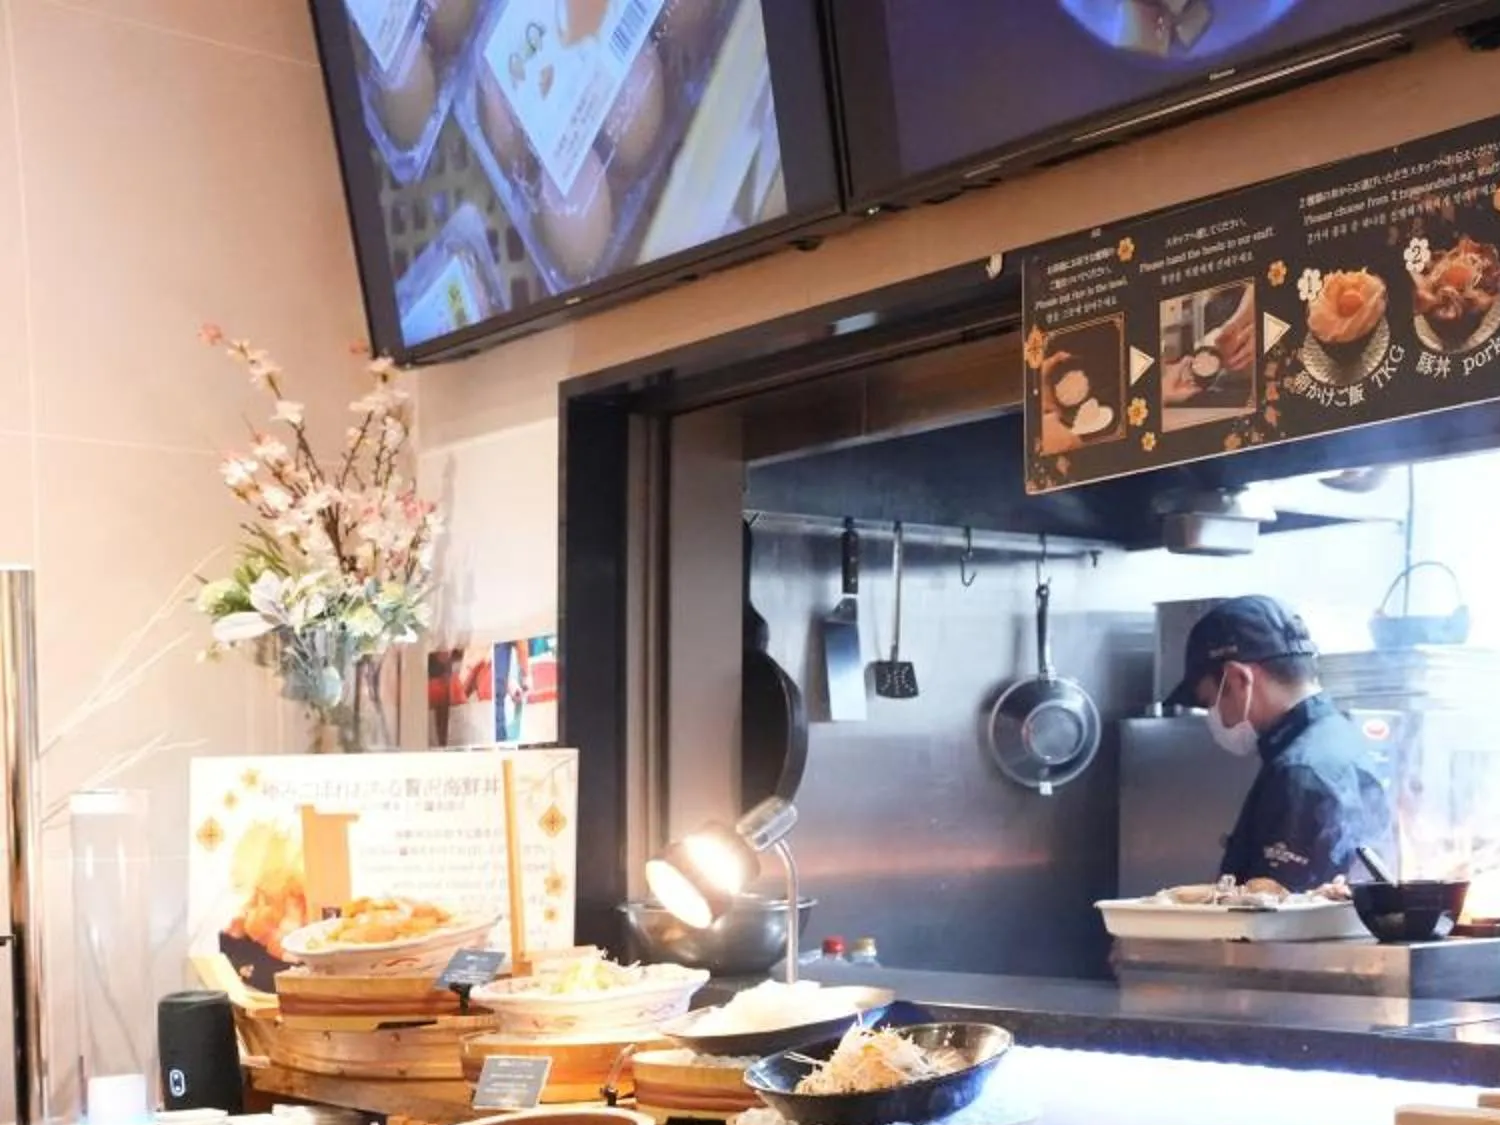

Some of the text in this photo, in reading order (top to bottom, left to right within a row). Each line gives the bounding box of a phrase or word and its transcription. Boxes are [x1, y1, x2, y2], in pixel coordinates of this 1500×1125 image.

[1367, 194, 1389, 209] from
[1370, 343, 1405, 390] TKG
[1415, 351, 1451, 379] 豚丼
